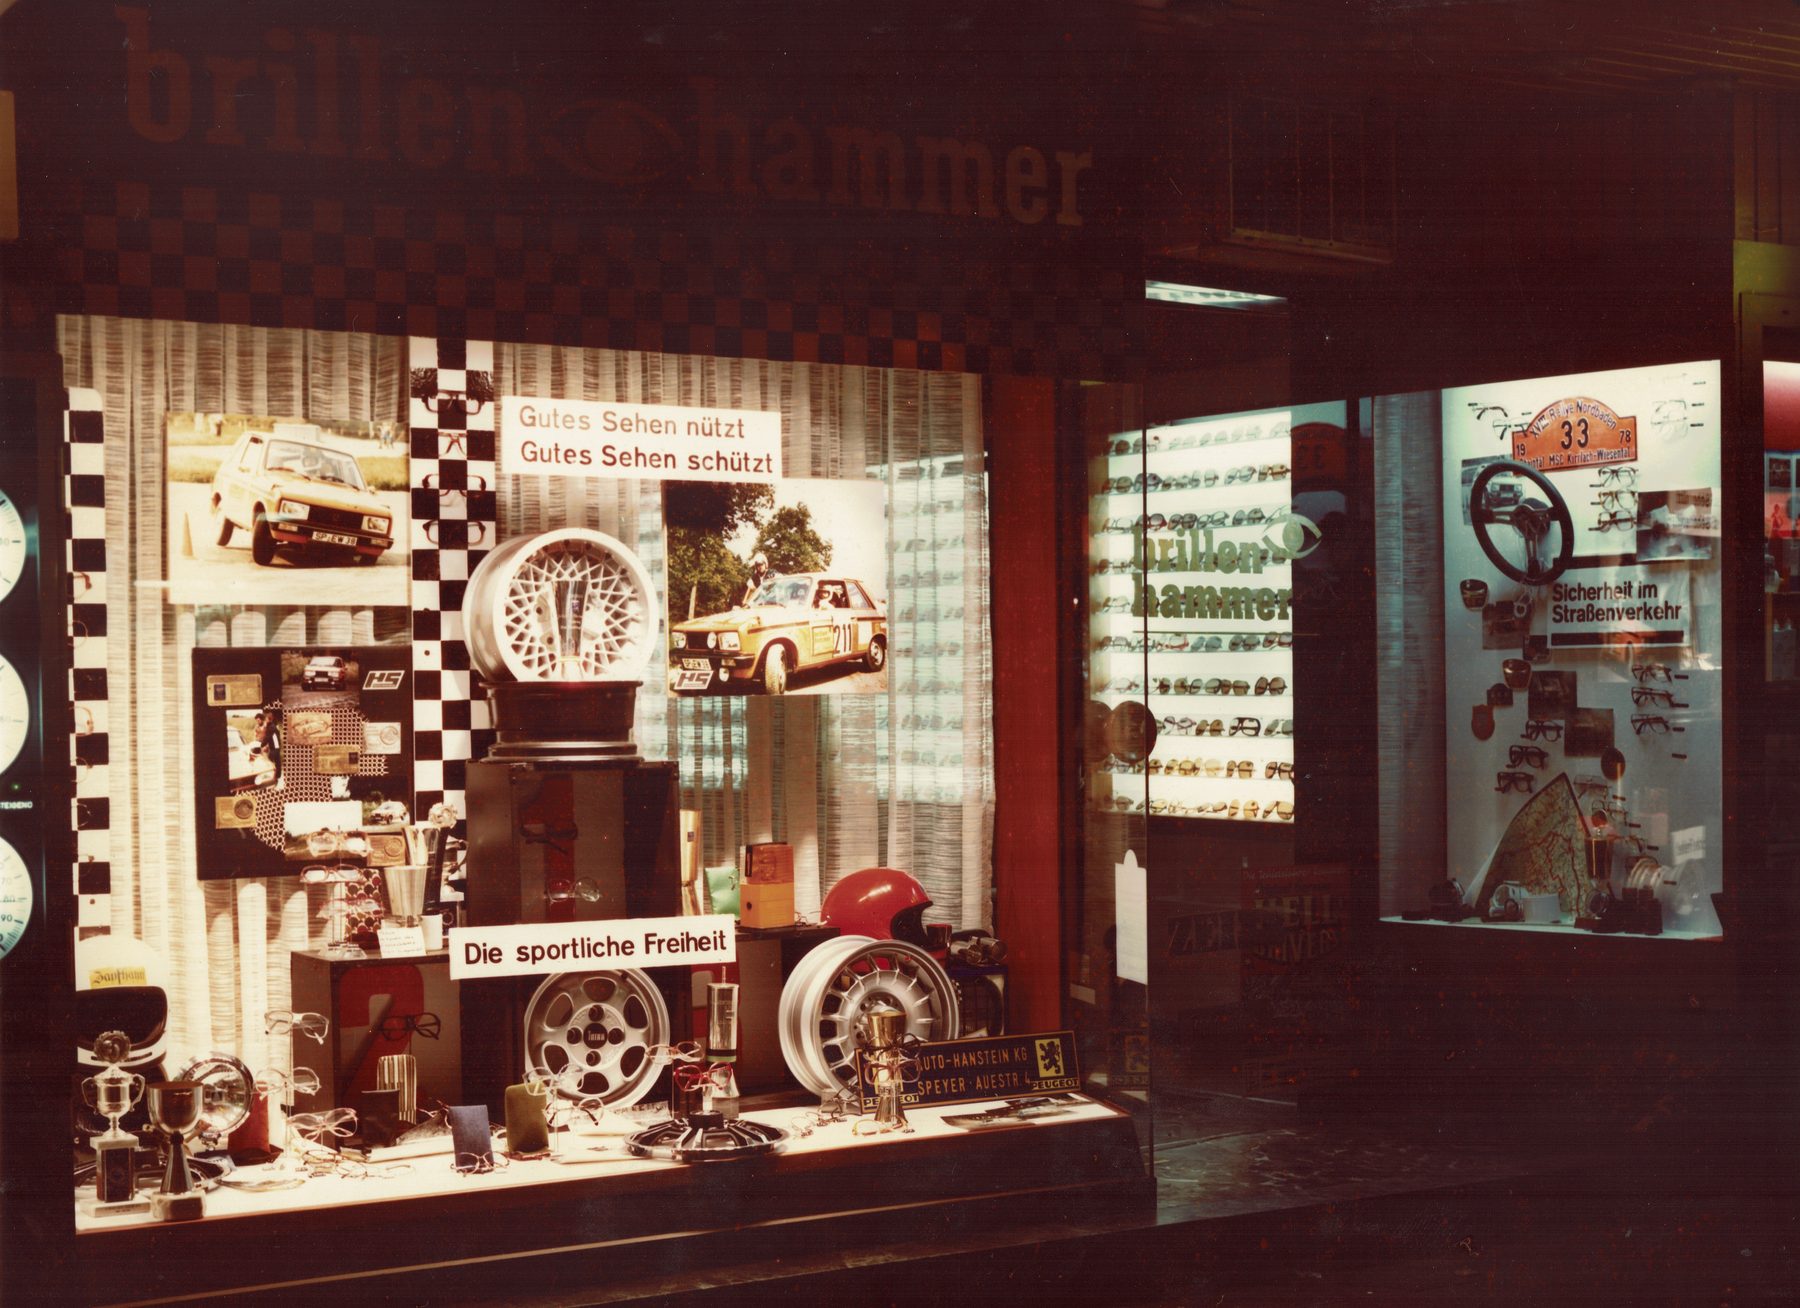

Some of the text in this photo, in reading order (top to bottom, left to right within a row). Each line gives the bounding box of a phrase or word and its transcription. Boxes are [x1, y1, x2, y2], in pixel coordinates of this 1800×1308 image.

[115, 5, 1092, 227] brillen hammer
[519, 405, 745, 439] Gutes Sehen nützt
[1576, 400, 1617, 430] Nordbaden
[1561, 418, 1589, 449] 33
[1619, 430, 1631, 443] 78
[521, 441, 773, 473] Gutes Sehen schützt
[1516, 443, 1526, 456] 19
[1549, 454, 1564, 466] MSC
[1131, 524, 1264, 574] brillen
[1131, 572, 1293, 621] hammer
[1552, 580, 1658, 602] Sicherheit im
[1552, 601, 1682, 624] Straßenverkehr
[0, 914, 13, 922] 90
[464, 929, 727, 965] Die sportliche Freiheit
[916, 1048, 1028, 1071] AUTO-HANSTEIN KG
[917, 1077, 966, 1096] SPEYER
[1032, 1079, 1079, 1090] PEUGEOT
[863, 1094, 918, 1106] PEEOT
